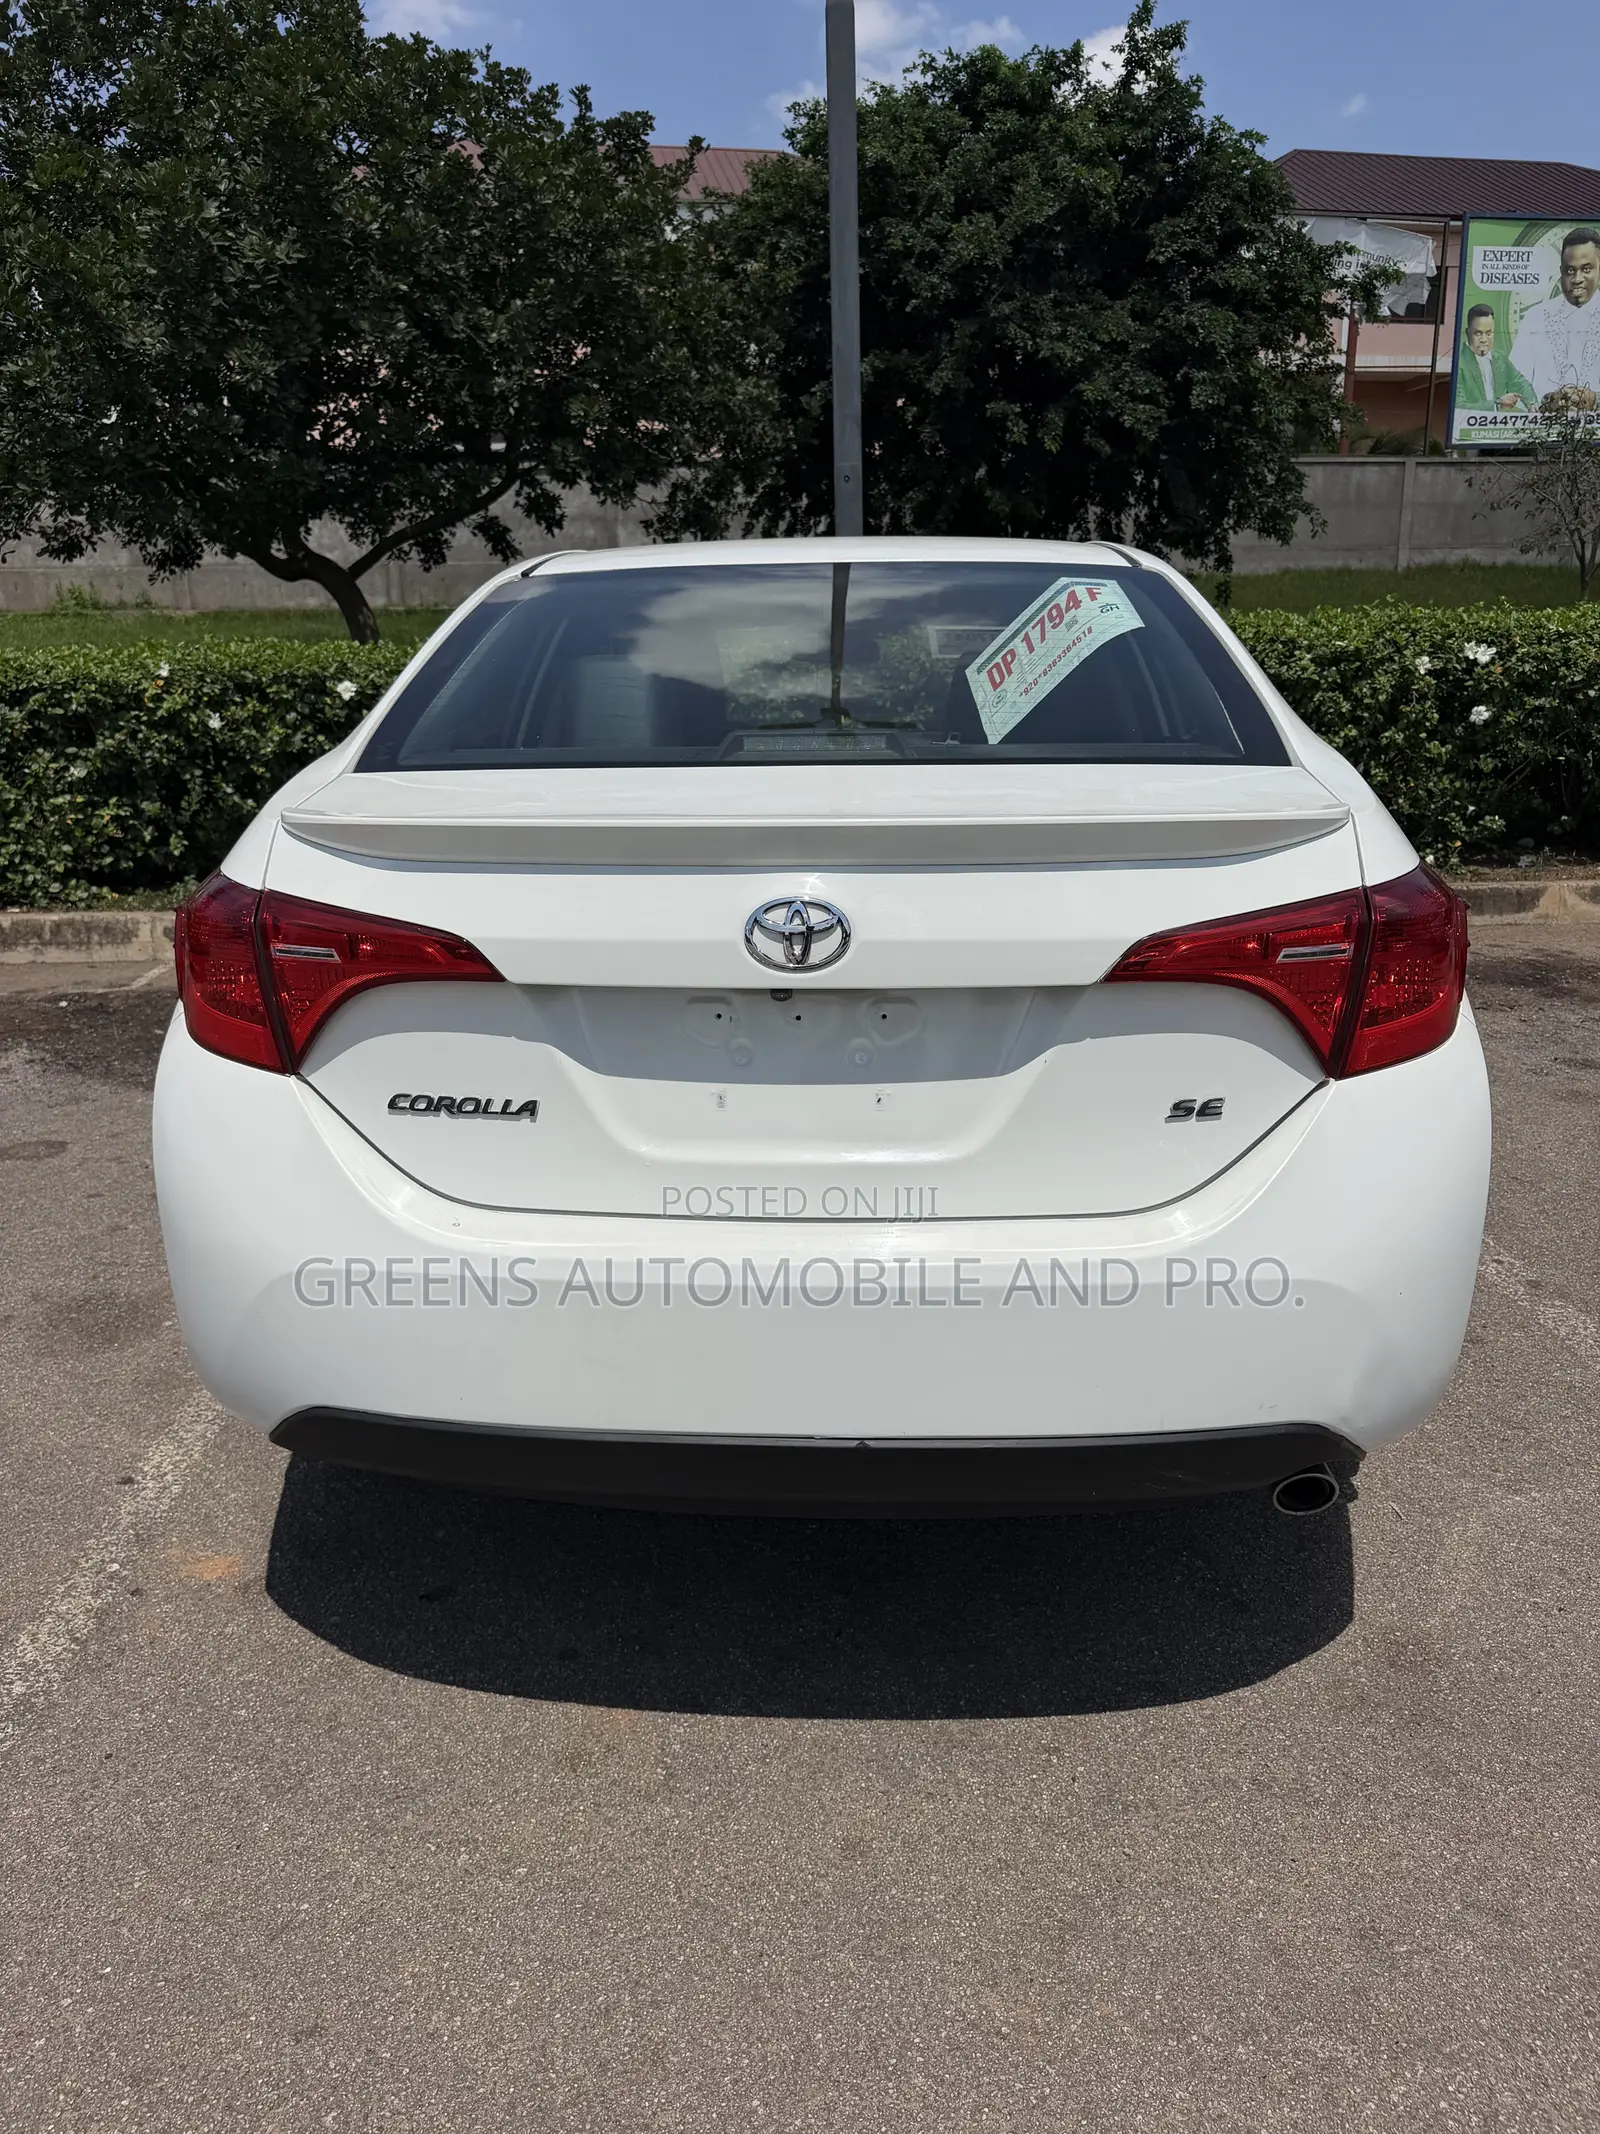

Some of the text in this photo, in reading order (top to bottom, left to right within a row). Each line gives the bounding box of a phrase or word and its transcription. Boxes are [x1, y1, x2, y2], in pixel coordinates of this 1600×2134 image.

[1482, 250, 1533, 262] EXPERT
[1480, 272, 1540, 285] DISEASES
[1100, 605, 1120, 614] GH
[986, 587, 1103, 692] DP 1794 F
[387, 1093, 540, 1121] COROLLA
[1165, 1097, 1225, 1122] SE
